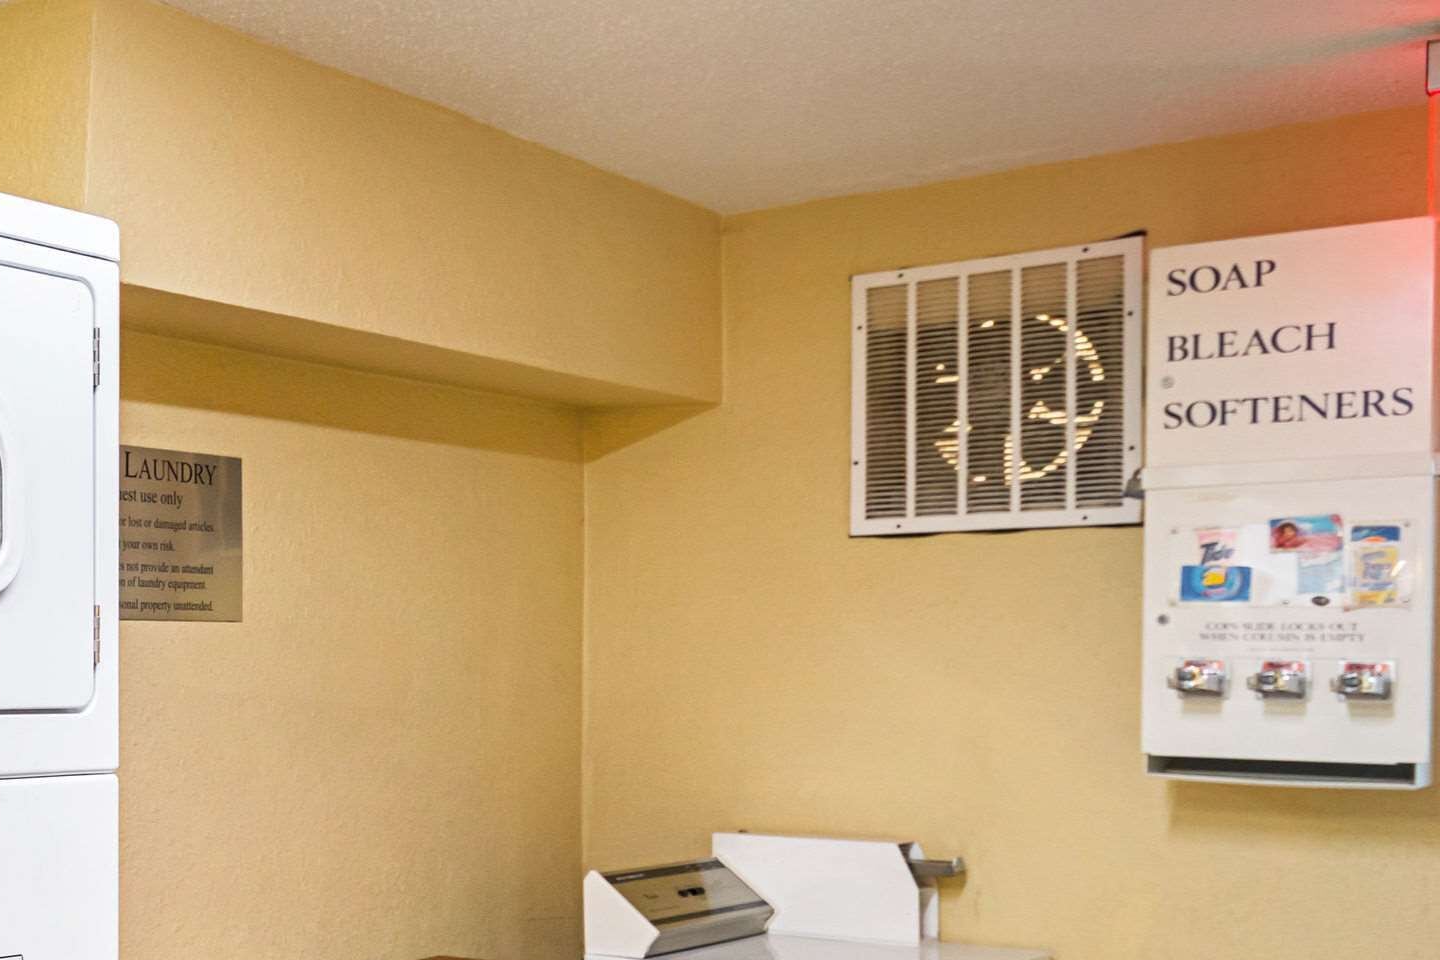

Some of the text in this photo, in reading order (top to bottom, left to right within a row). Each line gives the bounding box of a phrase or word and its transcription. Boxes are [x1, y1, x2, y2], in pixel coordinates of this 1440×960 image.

[1166, 258, 1277, 297] SOAP
[1166, 321, 1337, 362] BLEACH
[1163, 386, 1415, 430] SOFTENERS
[124, 450, 217, 486] LAUNDRY
[140, 491, 157, 503] use
[160, 490, 184, 510] only
